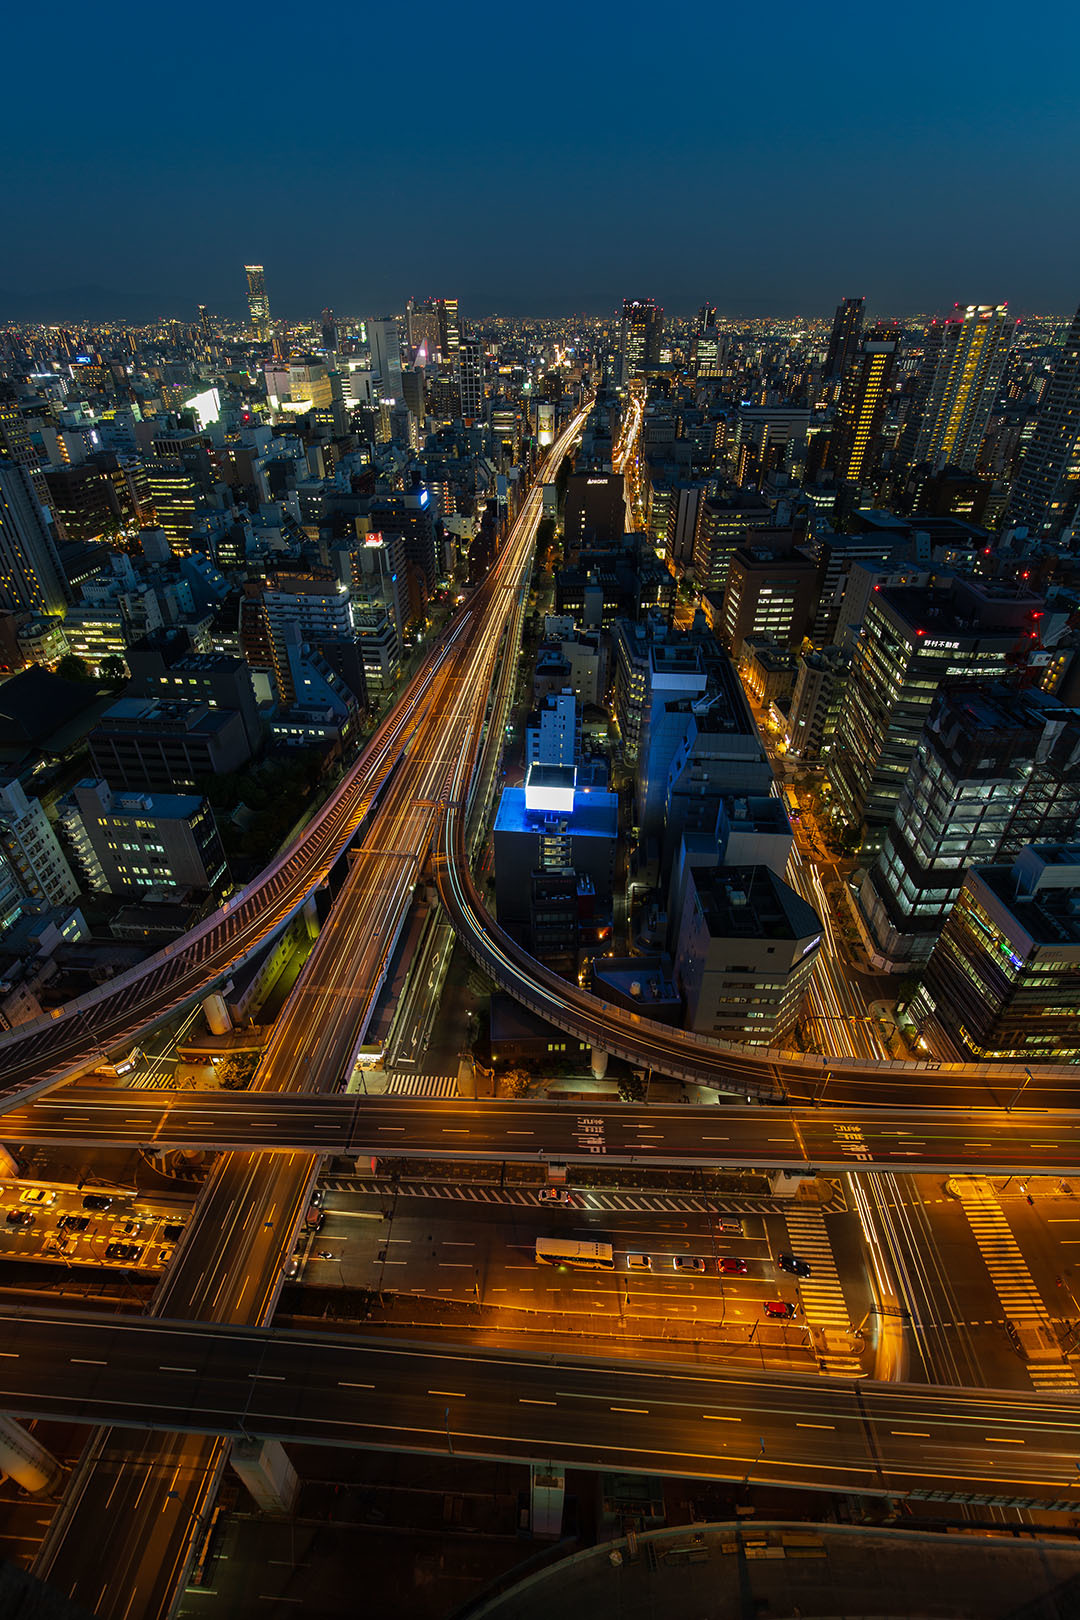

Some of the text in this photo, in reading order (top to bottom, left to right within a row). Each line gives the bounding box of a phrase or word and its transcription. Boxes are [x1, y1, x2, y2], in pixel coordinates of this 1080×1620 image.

[923, 639, 960, 649] 野村不動産
